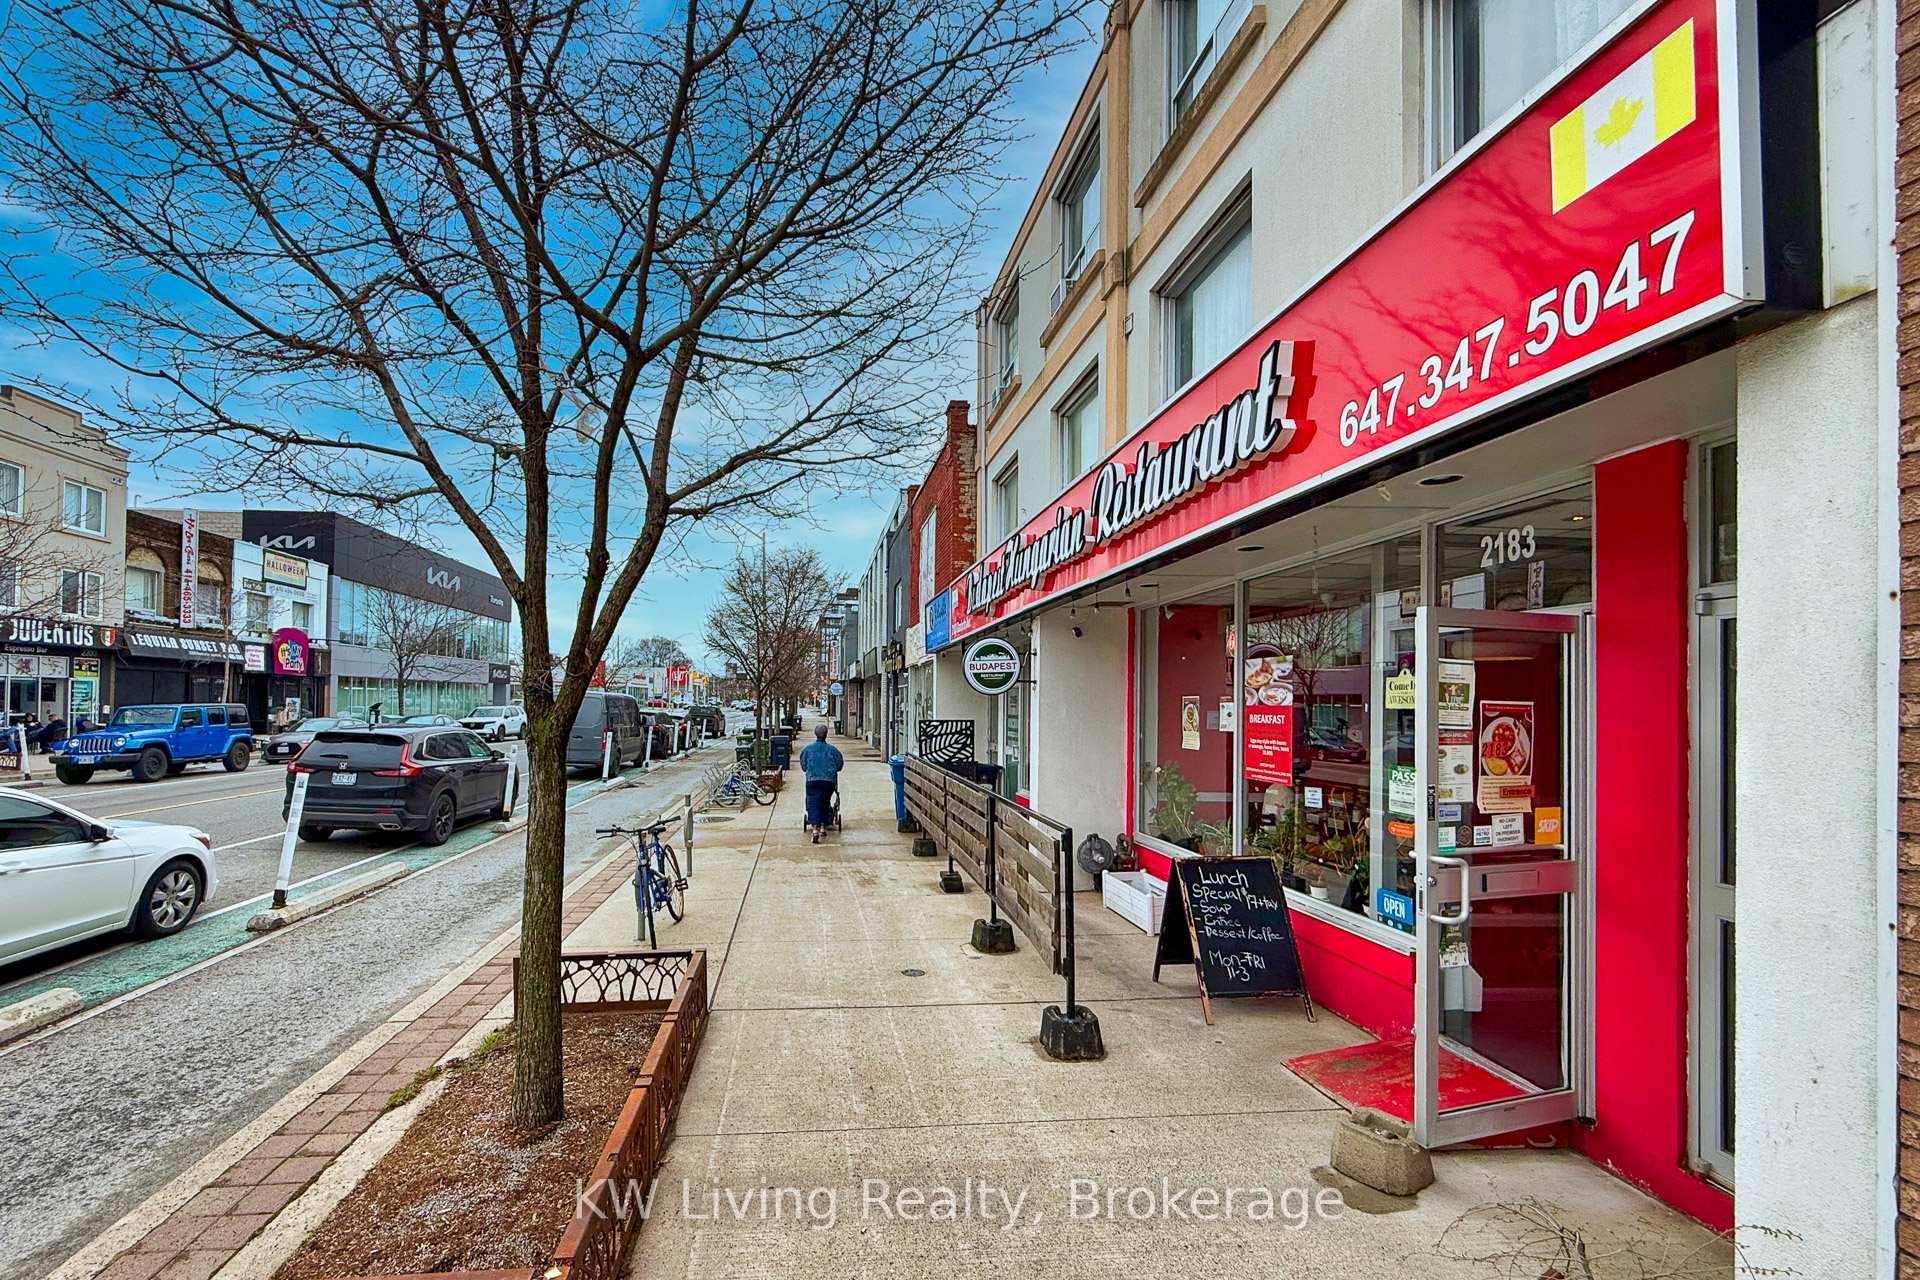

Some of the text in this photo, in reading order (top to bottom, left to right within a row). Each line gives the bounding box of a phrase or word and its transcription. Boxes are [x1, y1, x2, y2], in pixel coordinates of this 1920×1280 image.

[1338, 210, 1697, 449] 647.347.5047
[1003, 507, 1088, 592] Hungarian
[1091, 340, 1285, 543] Restaurant
[1480, 524, 1536, 568] 2183
[266, 560, 305, 576] HALLOWEEN
[4, 643, 35, 653] Espresso
[130, 633, 179, 649] TEQUILA
[179, 637, 218, 653] SUNSET
[286, 658, 304, 672] Party
[969, 662, 1018, 671] BUDAPEST
[1389, 681, 1410, 691] Come
[1249, 713, 1286, 725] BREAKFAST
[1198, 866, 1249, 888] Lunch
[1192, 883, 1243, 902] Special
[1383, 896, 1406, 919] OPEN
